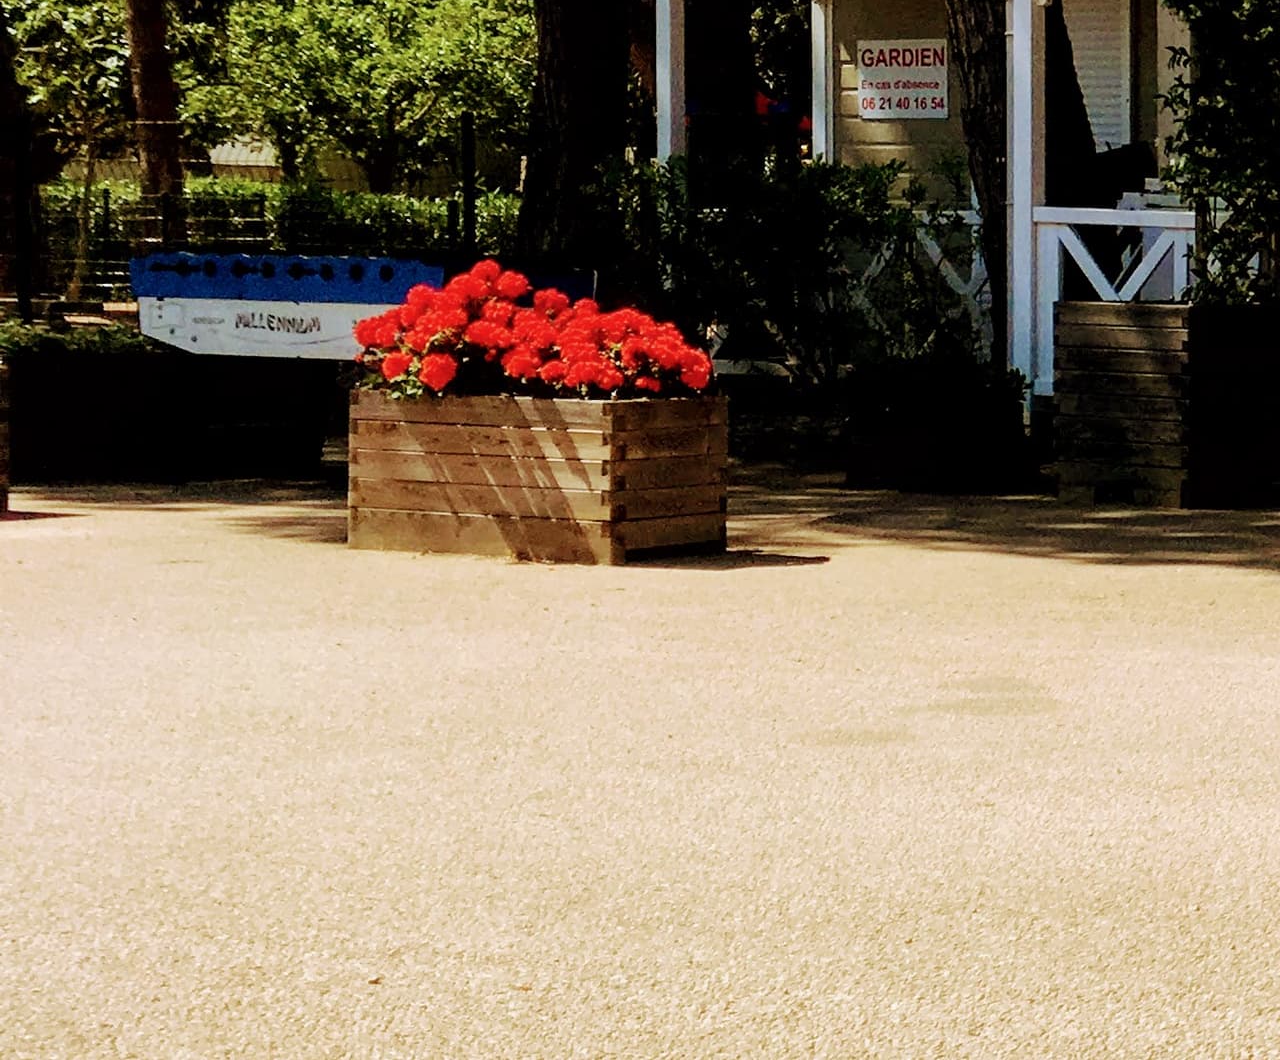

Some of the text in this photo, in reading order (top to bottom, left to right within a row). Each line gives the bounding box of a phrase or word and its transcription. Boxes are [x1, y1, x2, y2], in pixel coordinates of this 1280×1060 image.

[861, 46, 945, 67] GARDIEN
[875, 81, 891, 90] cas
[862, 97, 945, 110] 06 21 40 16 54
[235, 312, 321, 334] MILLENNIUM
